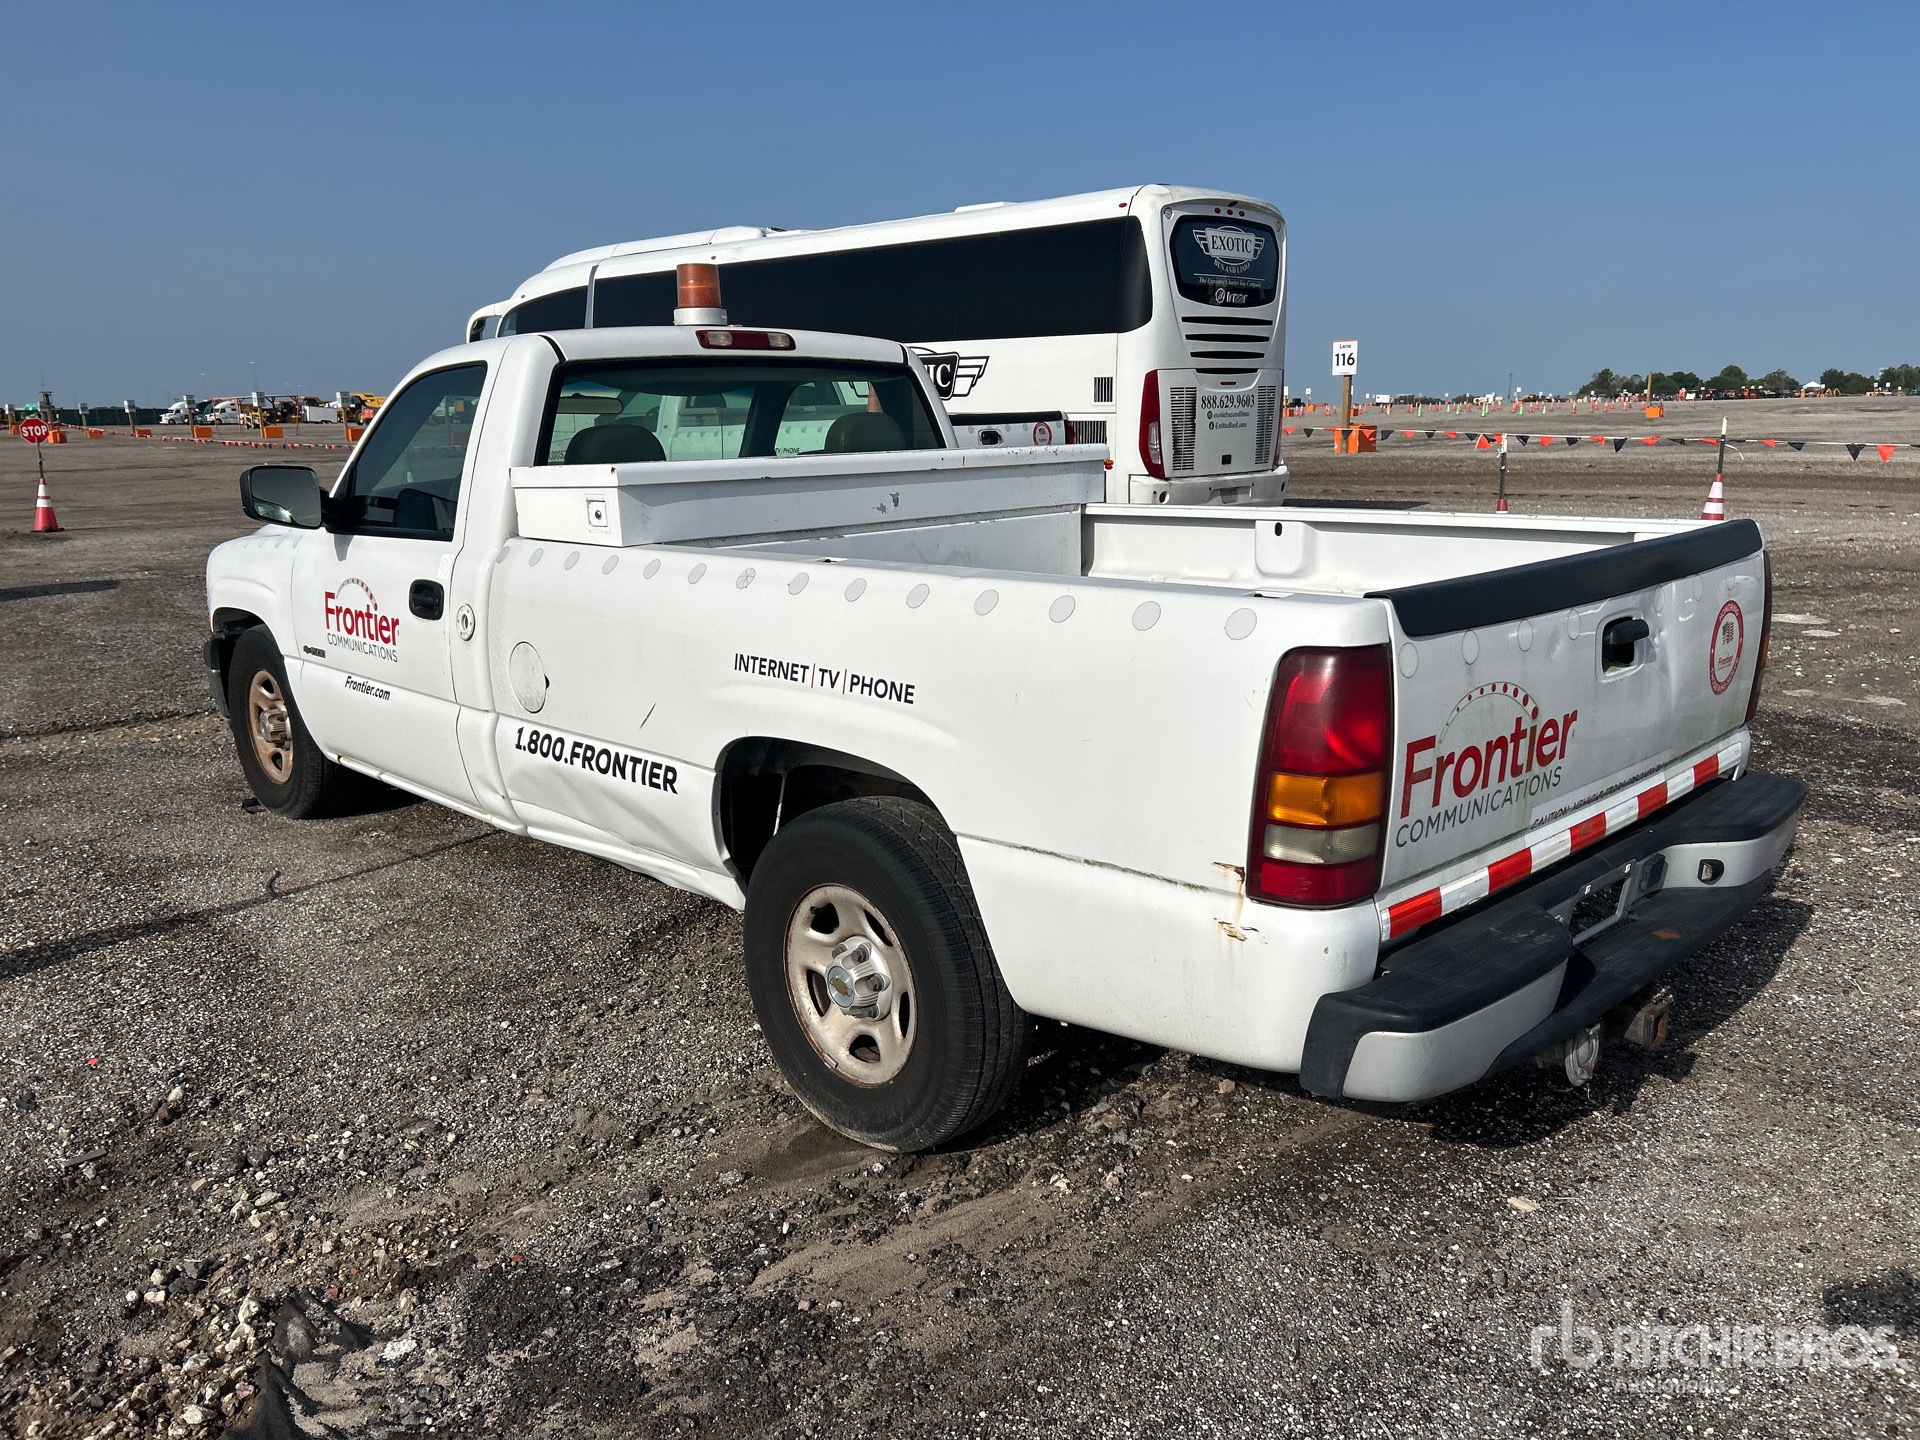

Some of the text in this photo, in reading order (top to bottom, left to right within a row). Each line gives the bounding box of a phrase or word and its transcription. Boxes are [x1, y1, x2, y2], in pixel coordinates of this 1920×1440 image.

[1211, 235, 1252, 254] EXOTIC
[1335, 352, 1355, 367] 116
[1201, 394, 1255, 409] 888.629.9603
[21, 425, 47, 437] STOP
[324, 591, 400, 646] Frontier
[327, 632, 398, 663] COMMUNICATIONS
[345, 676, 391, 701] Frontier.com
[734, 653, 916, 705] INTERNET TV PHONE
[514, 726, 679, 795] 1.800.FRONTIER
[1399, 708, 1578, 819] Frontier
[1395, 765, 1562, 848] COMMUNICATIONS
